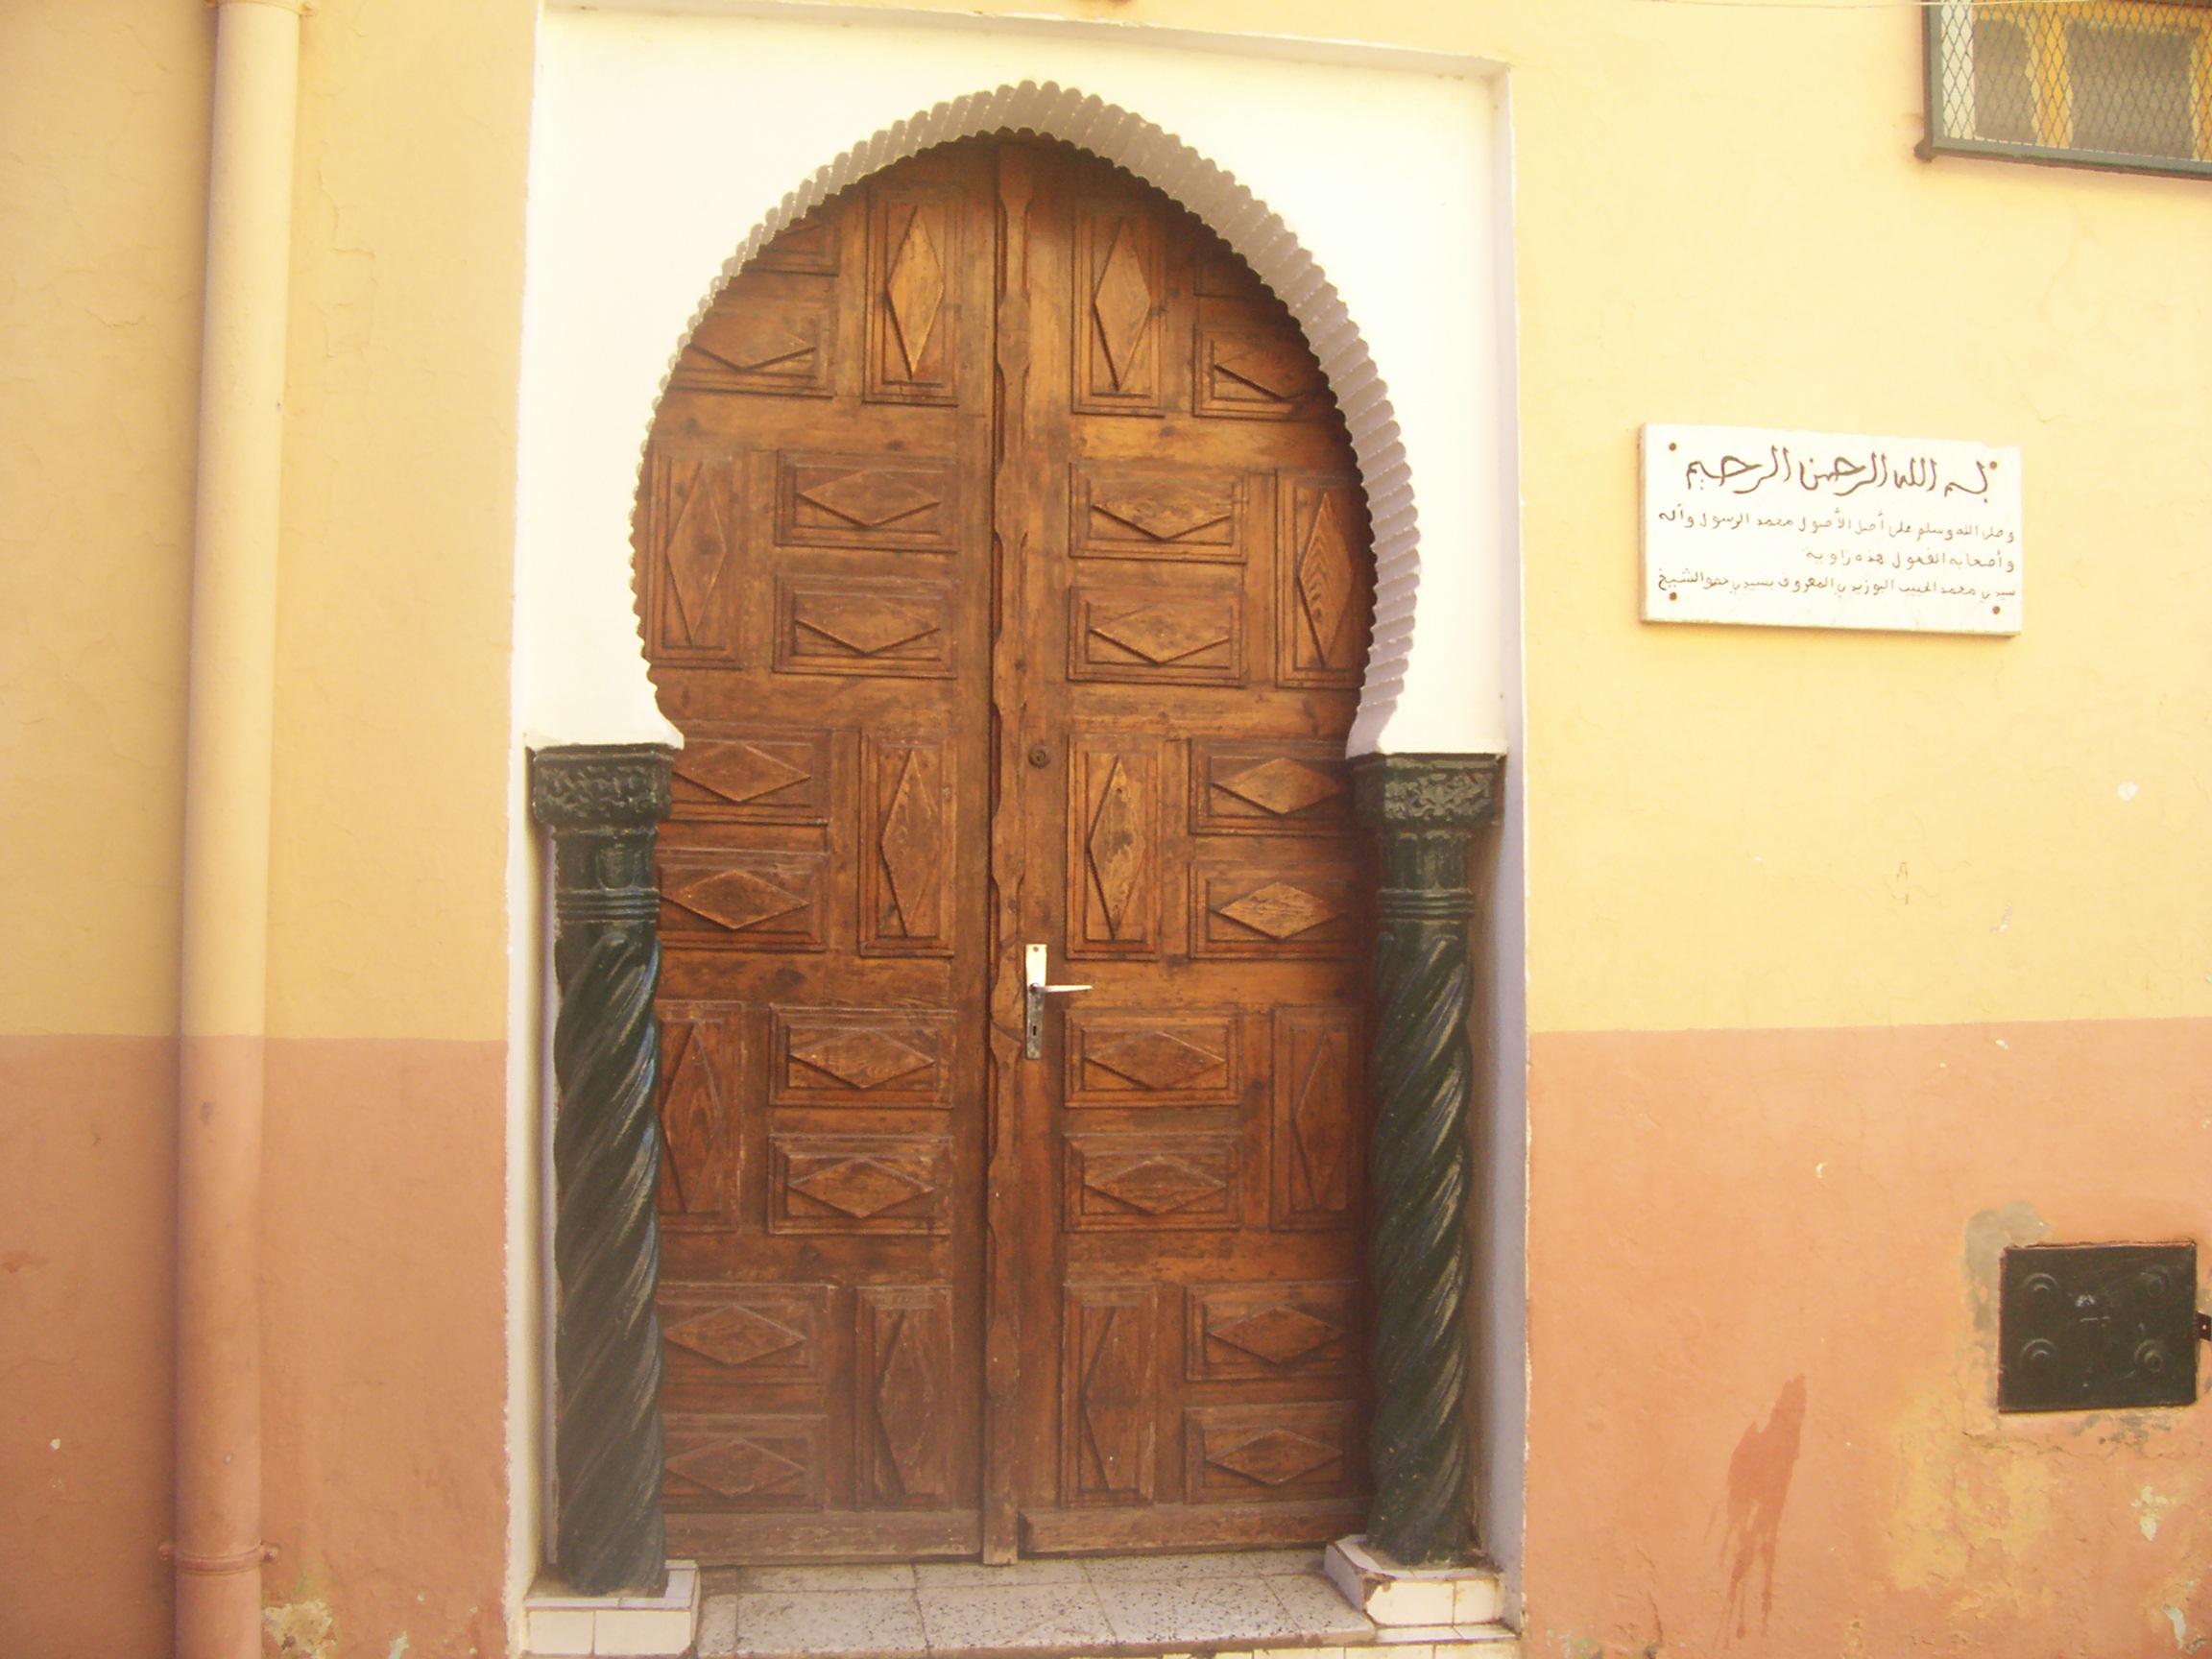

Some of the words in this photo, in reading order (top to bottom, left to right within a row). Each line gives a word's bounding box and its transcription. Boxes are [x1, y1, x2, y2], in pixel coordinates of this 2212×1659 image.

[1686, 445, 1791, 494] الرحيم
[1798, 451, 1887, 496] الرحمن
[1893, 456, 1936, 492] الله
[1699, 513, 1749, 530] الرسول
[1757, 518, 1793, 528] محمد
[1888, 520, 1911, 538] على
[1956, 524, 1978, 536] الله
[1916, 522, 1953, 541] وسلم
[1855, 550, 1884, 565] هذه
[1778, 571, 1834, 592] المعروف
[1899, 581, 1936, 597] الحبيب
[1940, 585, 1976, 595] محمد
[1980, 589, 2015, 603] سيدي
